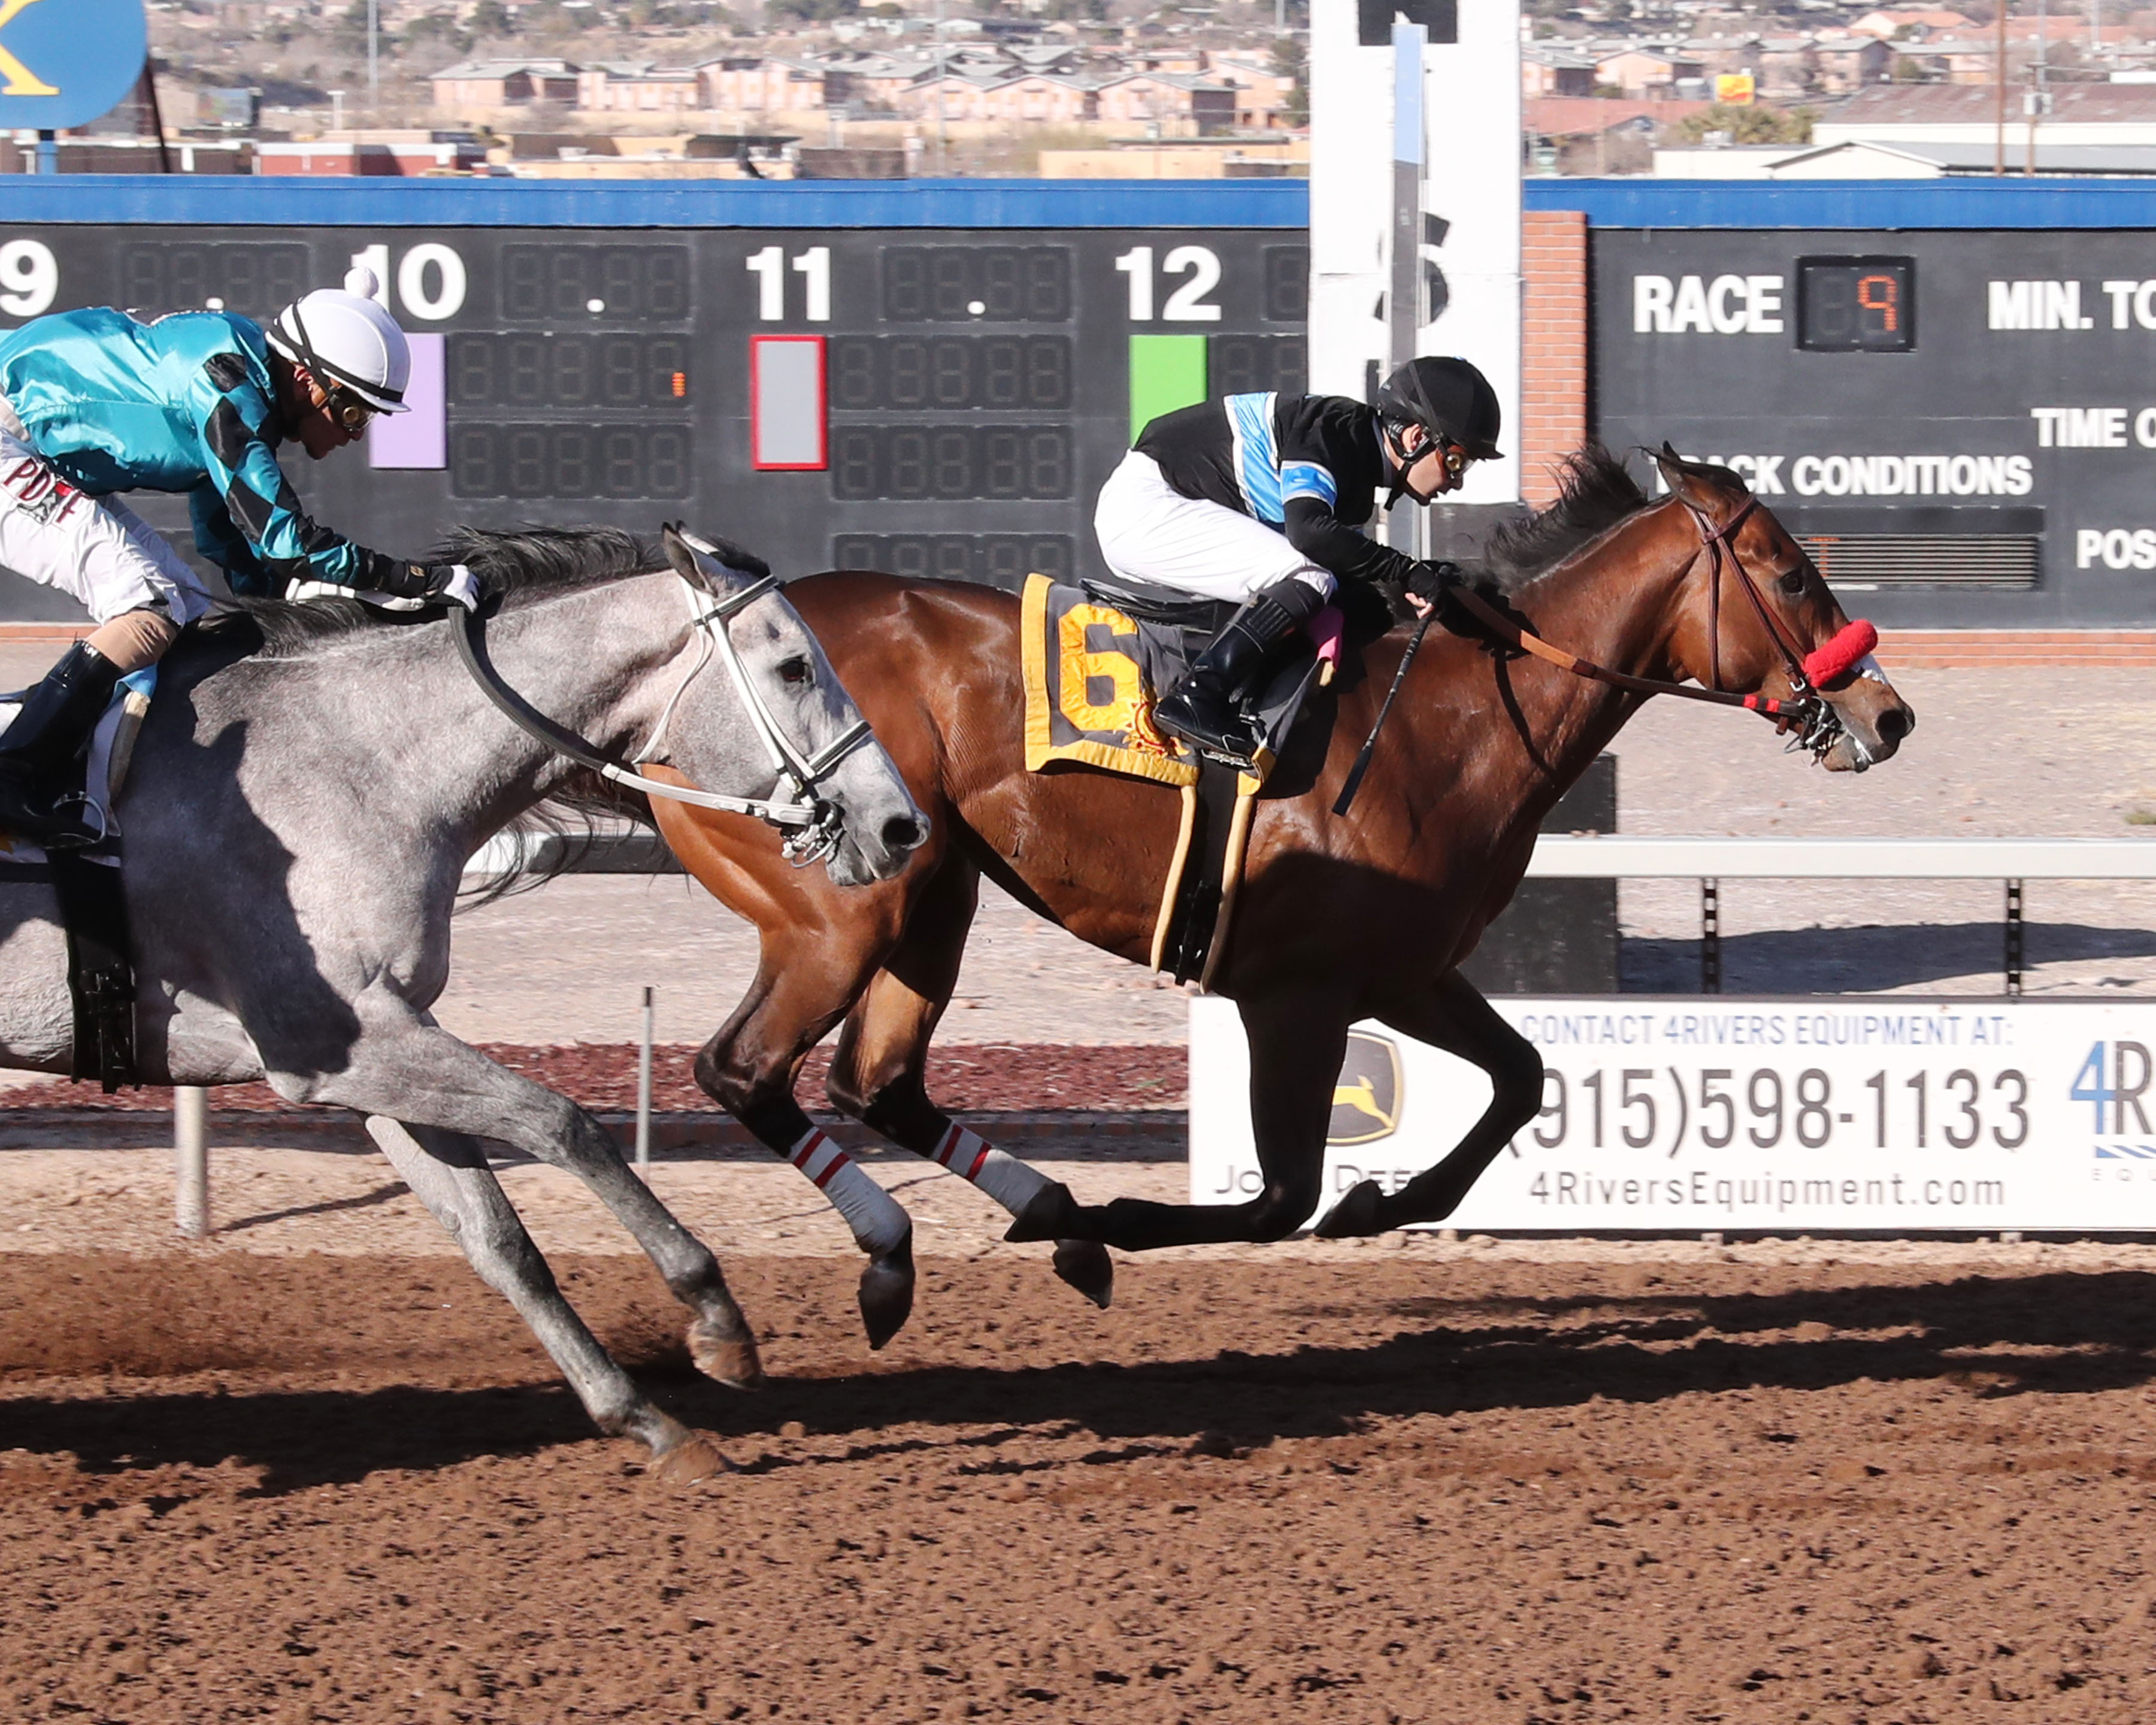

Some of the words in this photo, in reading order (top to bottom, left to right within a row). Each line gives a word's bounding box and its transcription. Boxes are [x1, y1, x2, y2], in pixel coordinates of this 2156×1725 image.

[0, 240, 58, 316] 9
[352, 243, 467, 320] 10
[746, 246, 830, 321] 11
[1115, 246, 1222, 321] 12
[1634, 274, 1784, 334] RACE
[1857, 276, 1897, 331] 9
[1988, 281, 2094, 329] MIN.
[2030, 408, 2128, 447] TIME
[1648, 455, 1786, 495] TCK
[1792, 455, 2033, 496] CONDITIONS
[2076, 529, 2156, 569] POS
[1058, 604, 1140, 731] 6
[1523, 1015, 1655, 1045] CONTACT
[1661, 1015, 1786, 1045] 4RIVERS
[1795, 1015, 1964, 1046] EQUIPMENT
[1970, 1015, 2015, 1045] AT:
[1509, 1066, 2028, 1158] 915)598-1133
[1529, 1171, 2004, 1212] 4RiversEquipment.com
